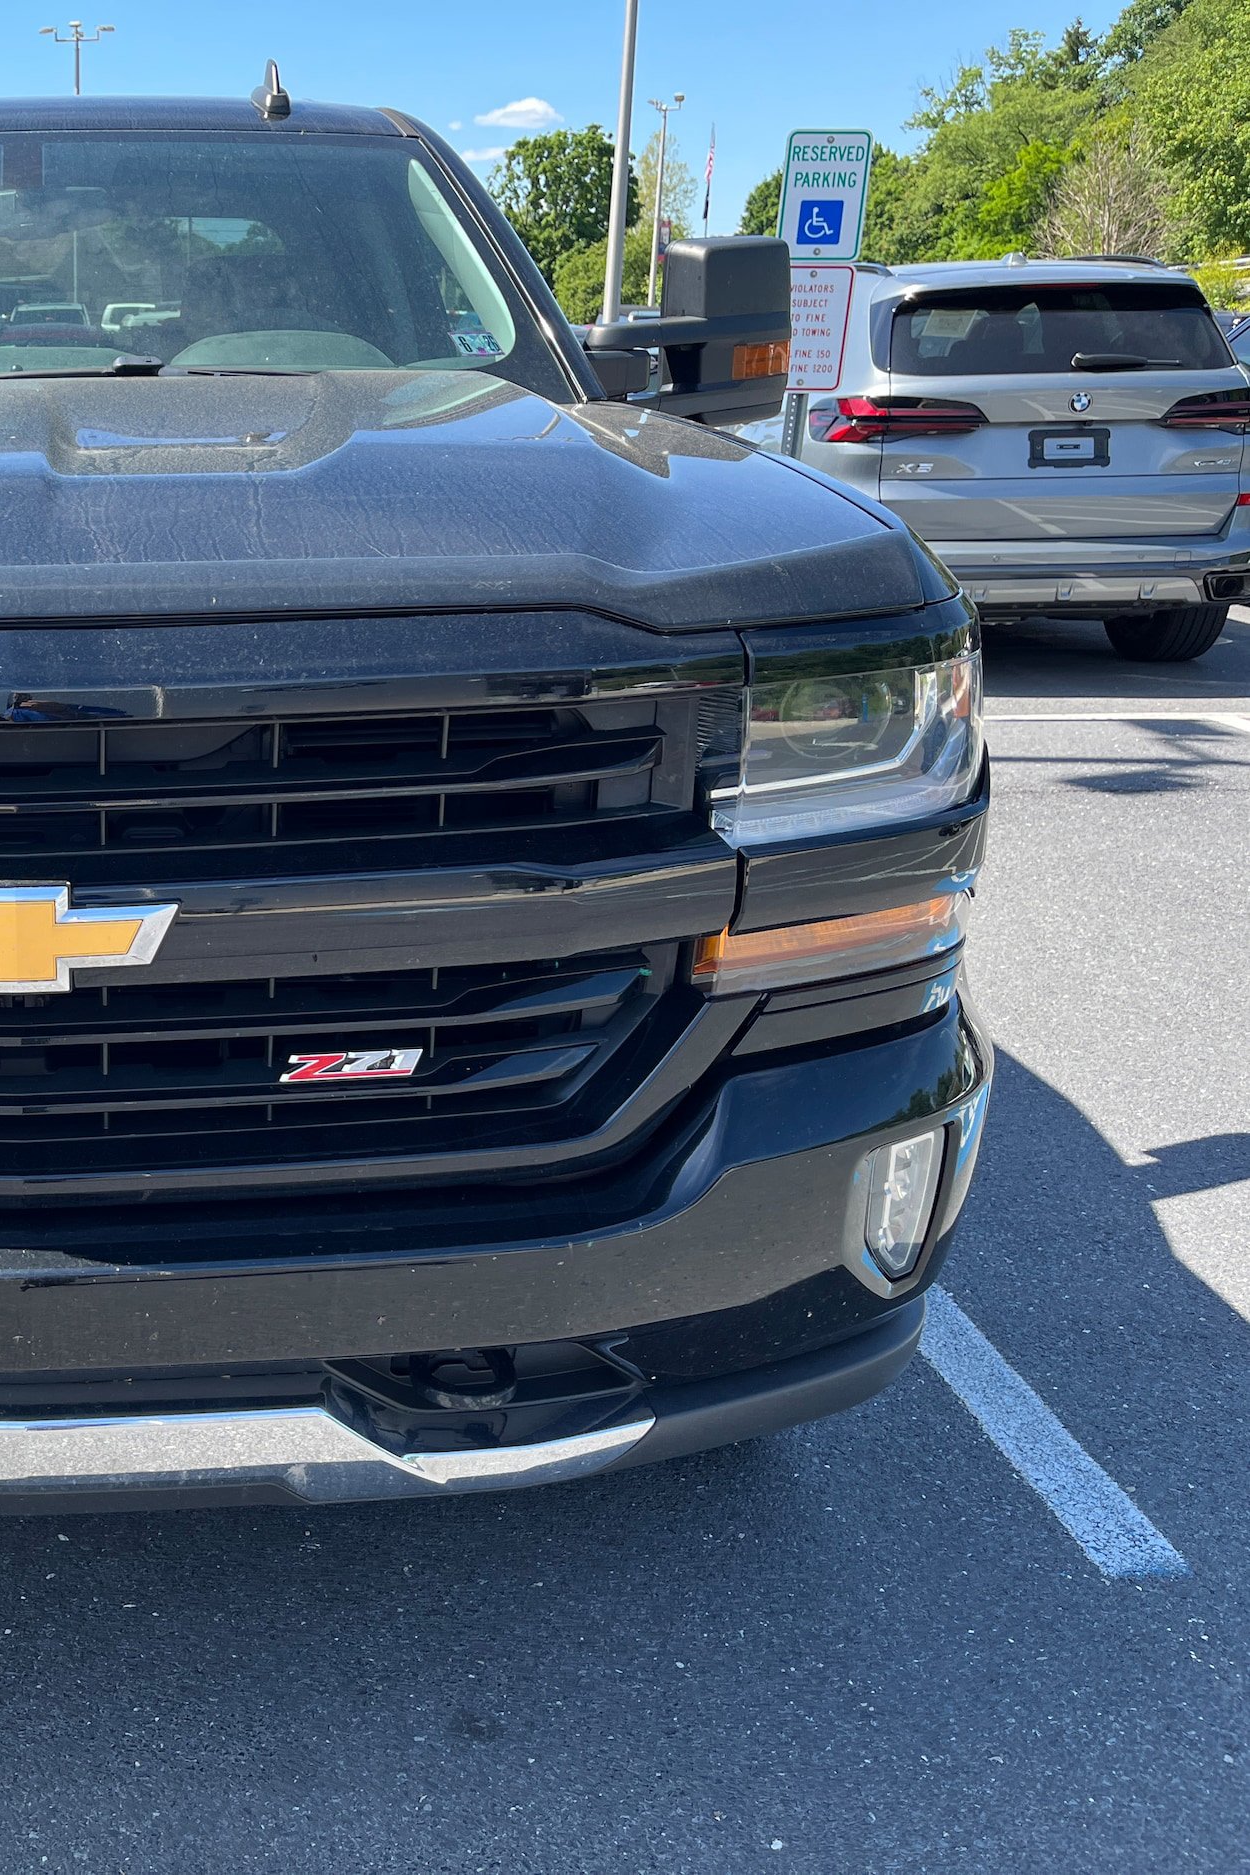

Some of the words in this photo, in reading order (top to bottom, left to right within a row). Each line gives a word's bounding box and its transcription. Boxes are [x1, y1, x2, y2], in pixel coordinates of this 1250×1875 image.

[792, 145, 865, 161] RESERVED
[794, 172, 857, 188] PARKING
[792, 299, 828, 308] SUBJECT
[791, 314, 801, 322] TO
[806, 313, 826, 322] FINE
[802, 328, 831, 337] TOWING
[795, 350, 812, 358] FINE
[790, 364, 808, 373] FINE
[896, 463, 934, 473] X5
[279, 1048, 424, 1082] Z71
